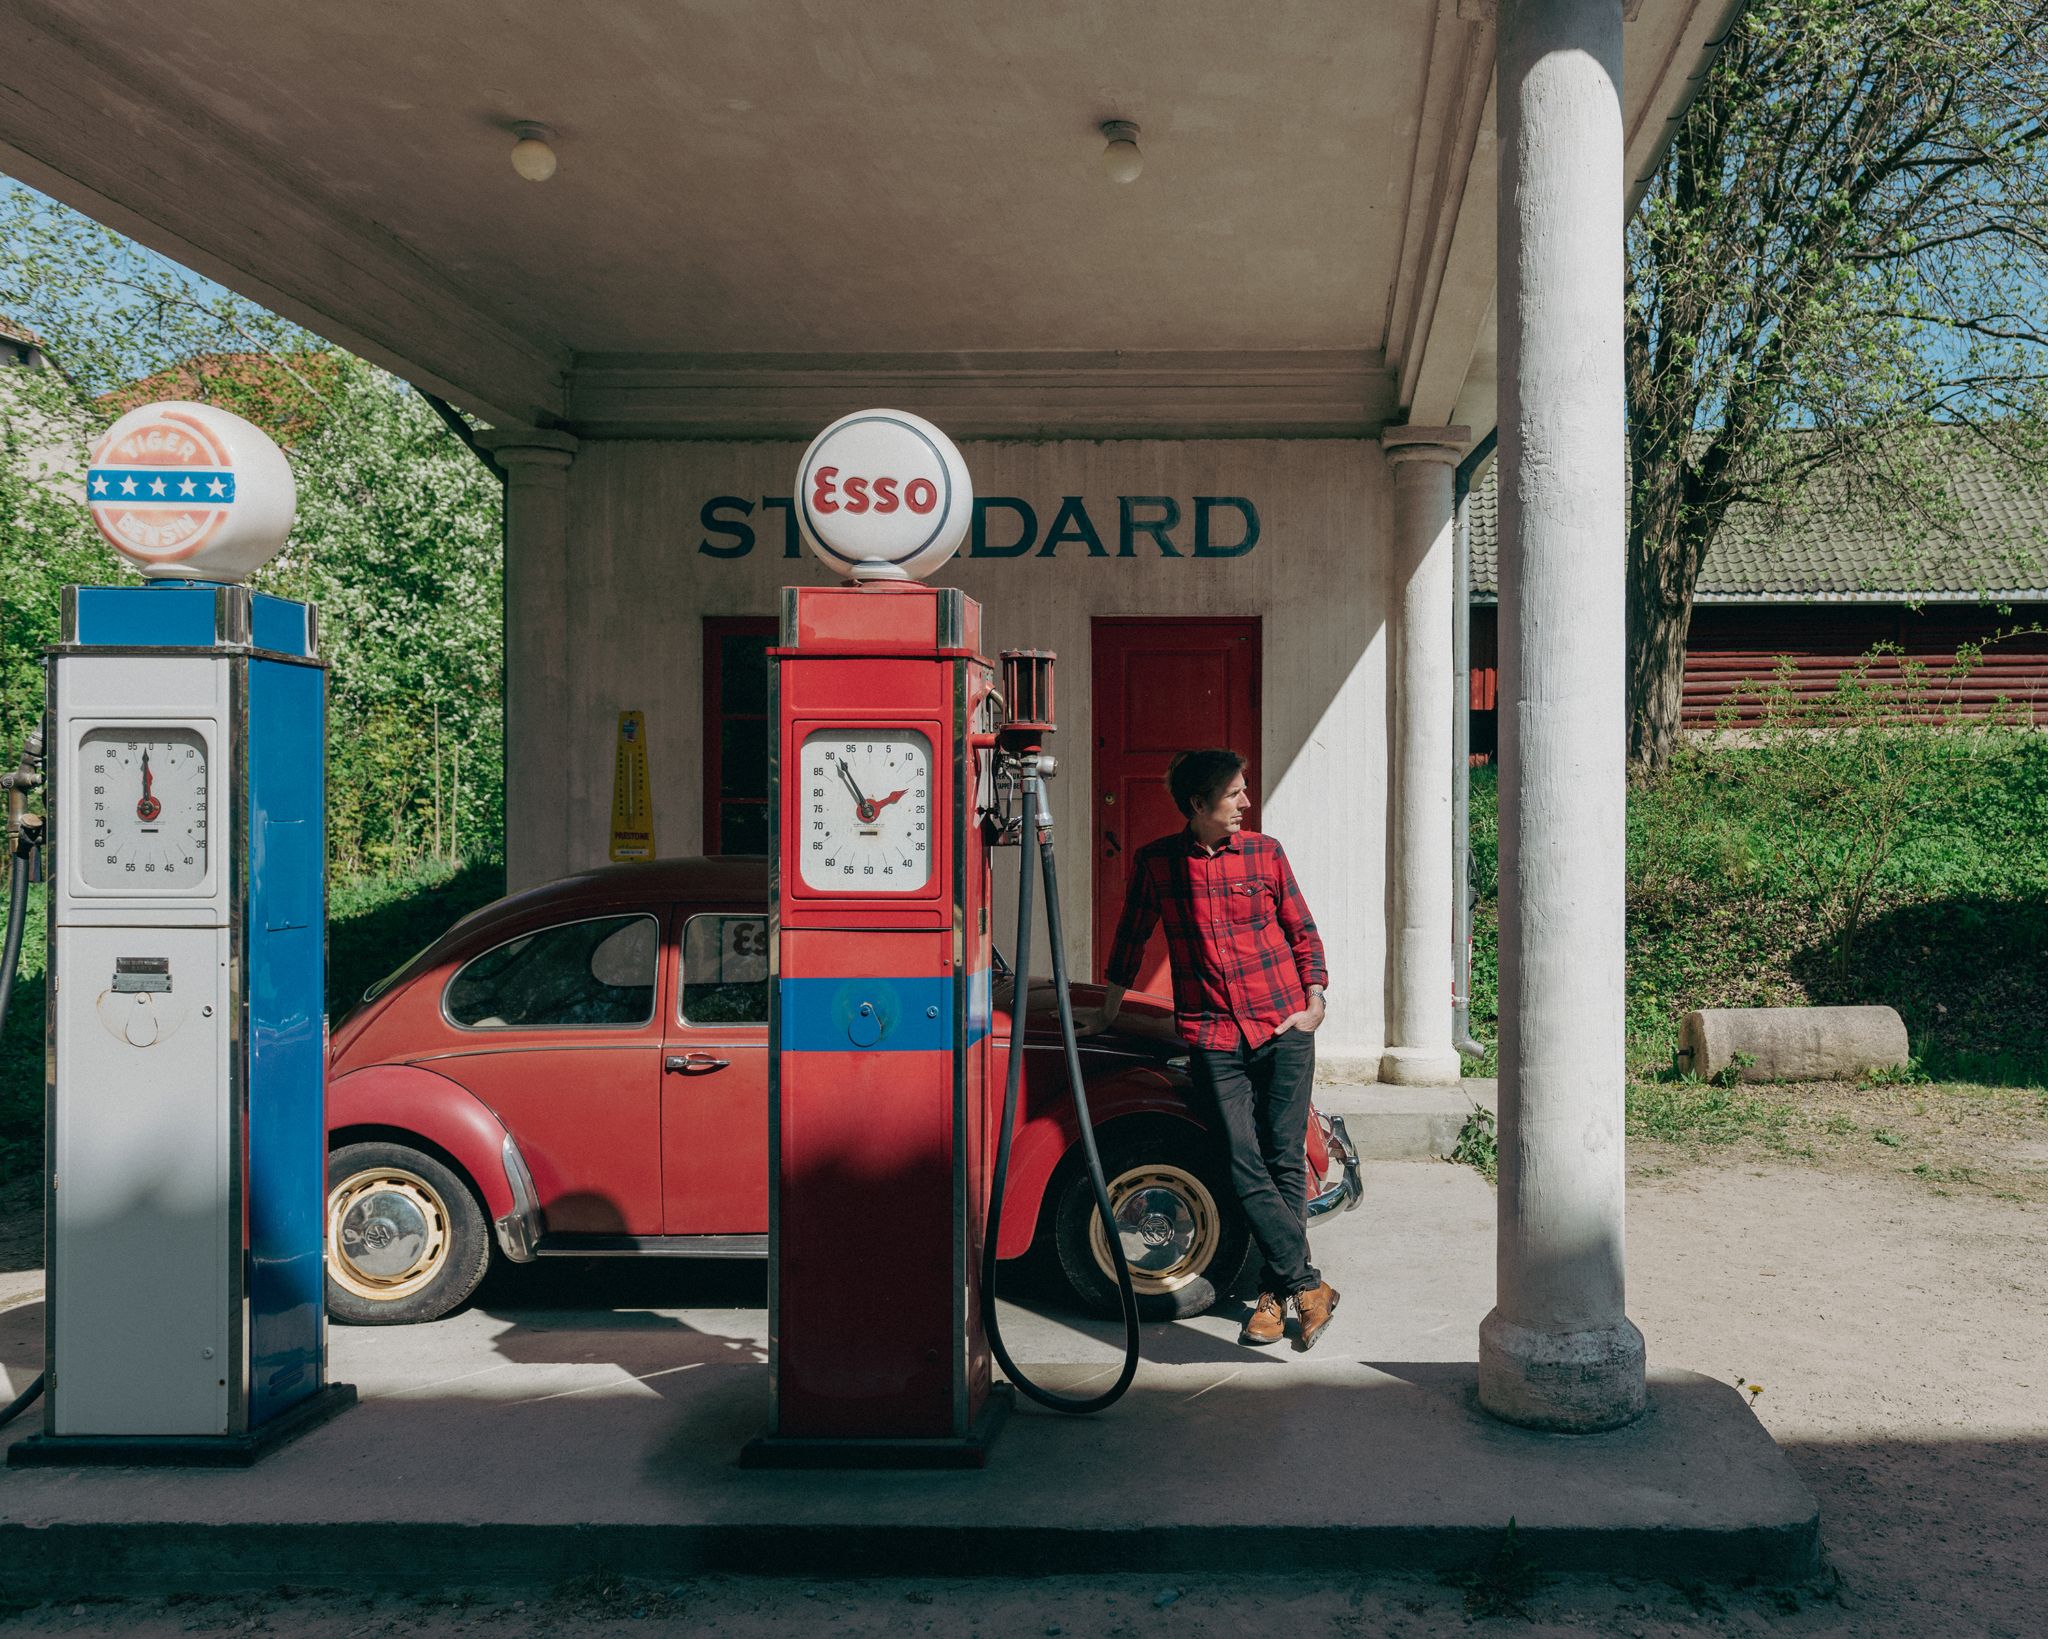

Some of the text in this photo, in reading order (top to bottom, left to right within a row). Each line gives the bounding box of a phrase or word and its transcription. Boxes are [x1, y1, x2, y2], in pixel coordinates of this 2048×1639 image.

[119, 430, 196, 461] TIGER
[116, 512, 198, 547] BENSIN
[697, 496, 1261, 559] STDARD
[846, 745, 856, 753] 95
[867, 745, 873, 753] 0
[886, 745, 892, 753] 5
[187, 750, 194, 758] 10
[825, 752, 835, 760] 90
[94, 765, 105, 773] 85
[916, 768, 925, 776] 15
[197, 787, 206, 795] 20
[813, 789, 824, 797] 80
[916, 790, 925, 798] 20
[197, 803, 207, 811] 25
[814, 805, 823, 813] 75
[95, 819, 105, 827] 70
[197, 820, 206, 828] 30
[814, 822, 823, 830] 70
[916, 822, 925, 830] 30
[813, 842, 823, 850] 65
[915, 843, 925, 851] 35
[107, 856, 117, 864] 60
[183, 857, 194, 865] 40
[902, 859, 913, 867] 40
[126, 864, 136, 872] 55
[145, 864, 155, 872] 50
[164, 864, 175, 872] 45
[844, 866, 854, 874] 55
[864, 866, 874, 874] 50
[883, 866, 893, 874] 45
